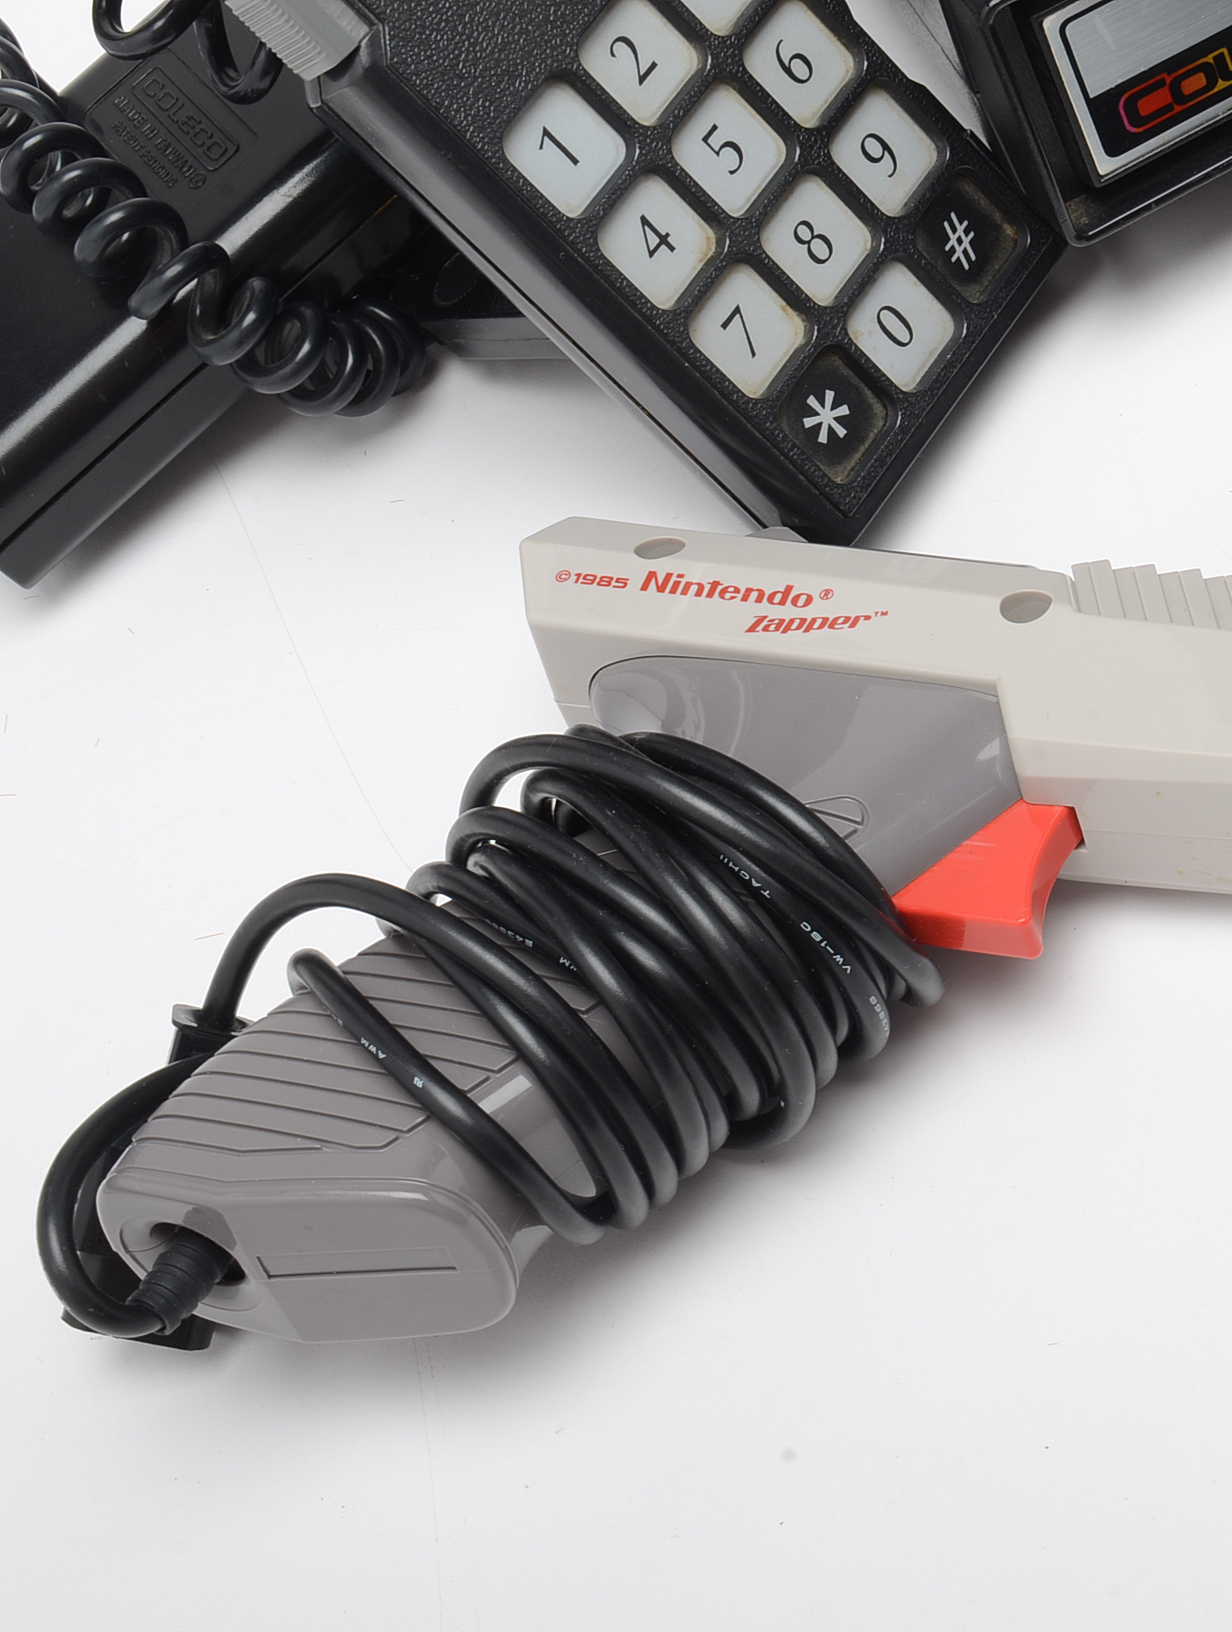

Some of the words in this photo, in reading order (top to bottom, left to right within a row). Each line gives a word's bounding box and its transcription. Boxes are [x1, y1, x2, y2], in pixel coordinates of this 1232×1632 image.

[114, 95, 148, 128] MADE
[141, 123, 159, 140] IN
[154, 135, 196, 179] TAIWAN
[142, 78, 228, 161] COLECO
[538, 125, 581, 167] 1
[609, 35, 659, 87] 2
[639, 214, 677, 259] 4
[701, 123, 744, 176] 5
[775, 38, 814, 85] 6
[719, 304, 757, 360] 7
[792, 220, 834, 265] 8
[860, 132, 898, 178] 9
[876, 305, 915, 349] 0
[943, 211, 976, 271] #
[719, 854, 771, 899] TACHII
[800, 921, 852, 974] VW-1SC
[361, 1037, 387, 1059] AWM
